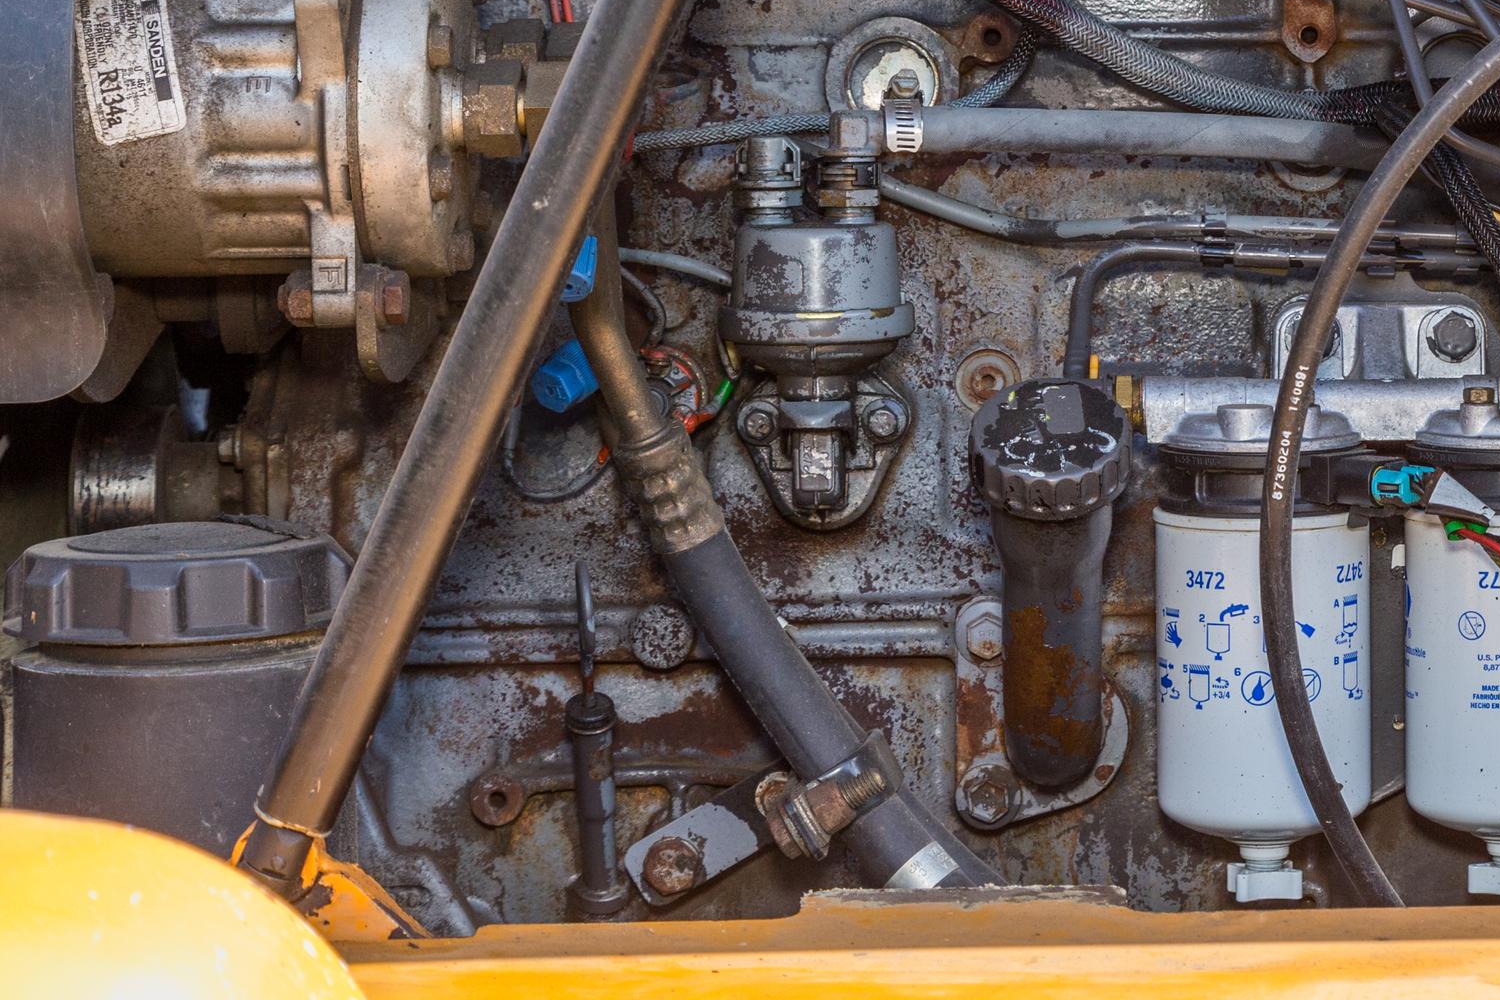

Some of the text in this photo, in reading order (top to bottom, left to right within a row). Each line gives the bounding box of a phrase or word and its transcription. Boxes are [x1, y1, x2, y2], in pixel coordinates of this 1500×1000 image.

[102, 21, 114, 48] OZONE
[93, 23, 108, 65] FRIENDLY
[146, 20, 168, 79] SANDEN
[97, 67, 128, 128] R134a
[1271, 430, 1292, 500] 87360204
[1335, 561, 1363, 583] 3472
[1185, 570, 1226, 590] 3472
[1333, 599, 1340, 608] A
[1199, 613, 1205, 623] 2
[1253, 615, 1260, 624] 3
[1333, 656, 1340, 665] B
[1477, 653, 1493, 661] U.S.
[1182, 664, 1188, 673] 5
[1234, 667, 1241, 677] 6
